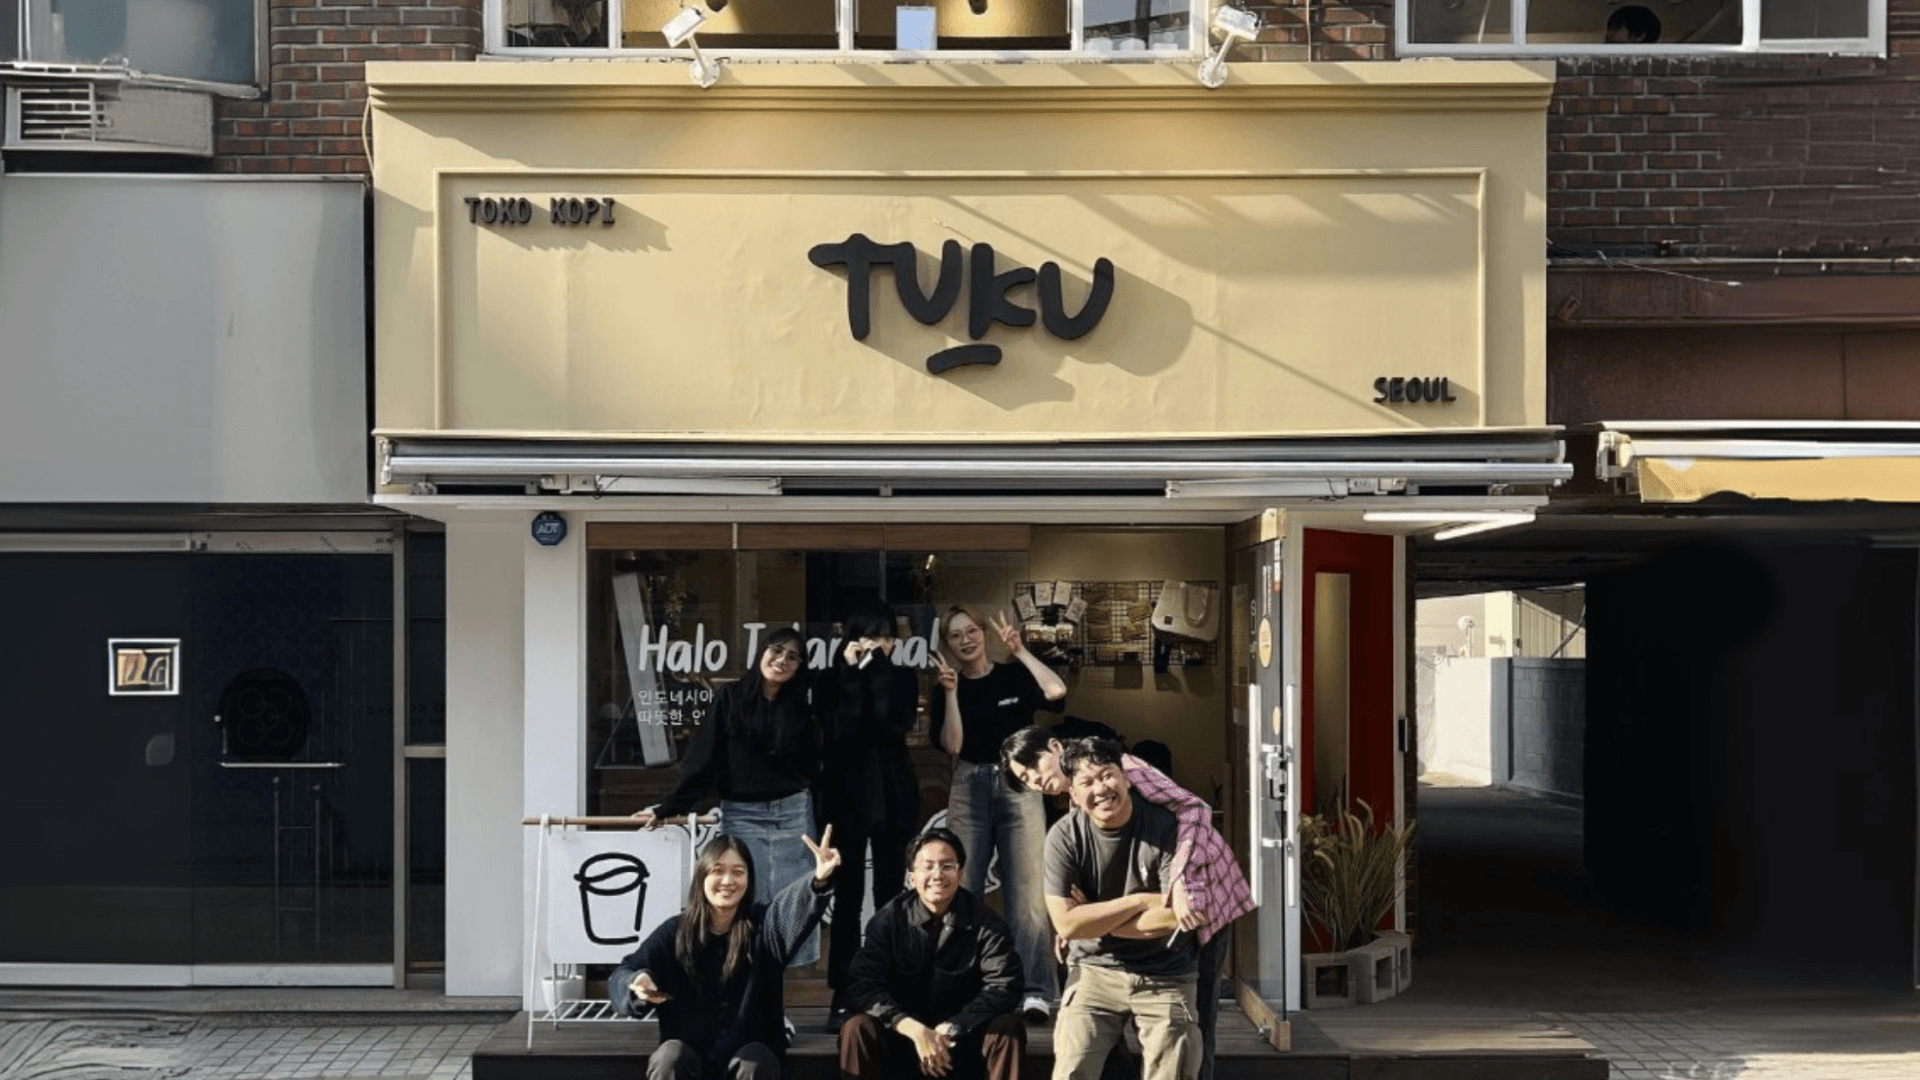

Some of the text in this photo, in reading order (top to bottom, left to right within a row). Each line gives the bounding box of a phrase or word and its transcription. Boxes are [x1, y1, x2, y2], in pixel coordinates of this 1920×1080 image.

[464, 197, 616, 225] TOKO KOPI
[1373, 376, 1457, 403] SEOUL
[536, 522, 560, 534] ADT
[638, 622, 728, 673] Halo
[638, 688, 714, 706] 인도네시아
[638, 709, 684, 726] 따뜻한
